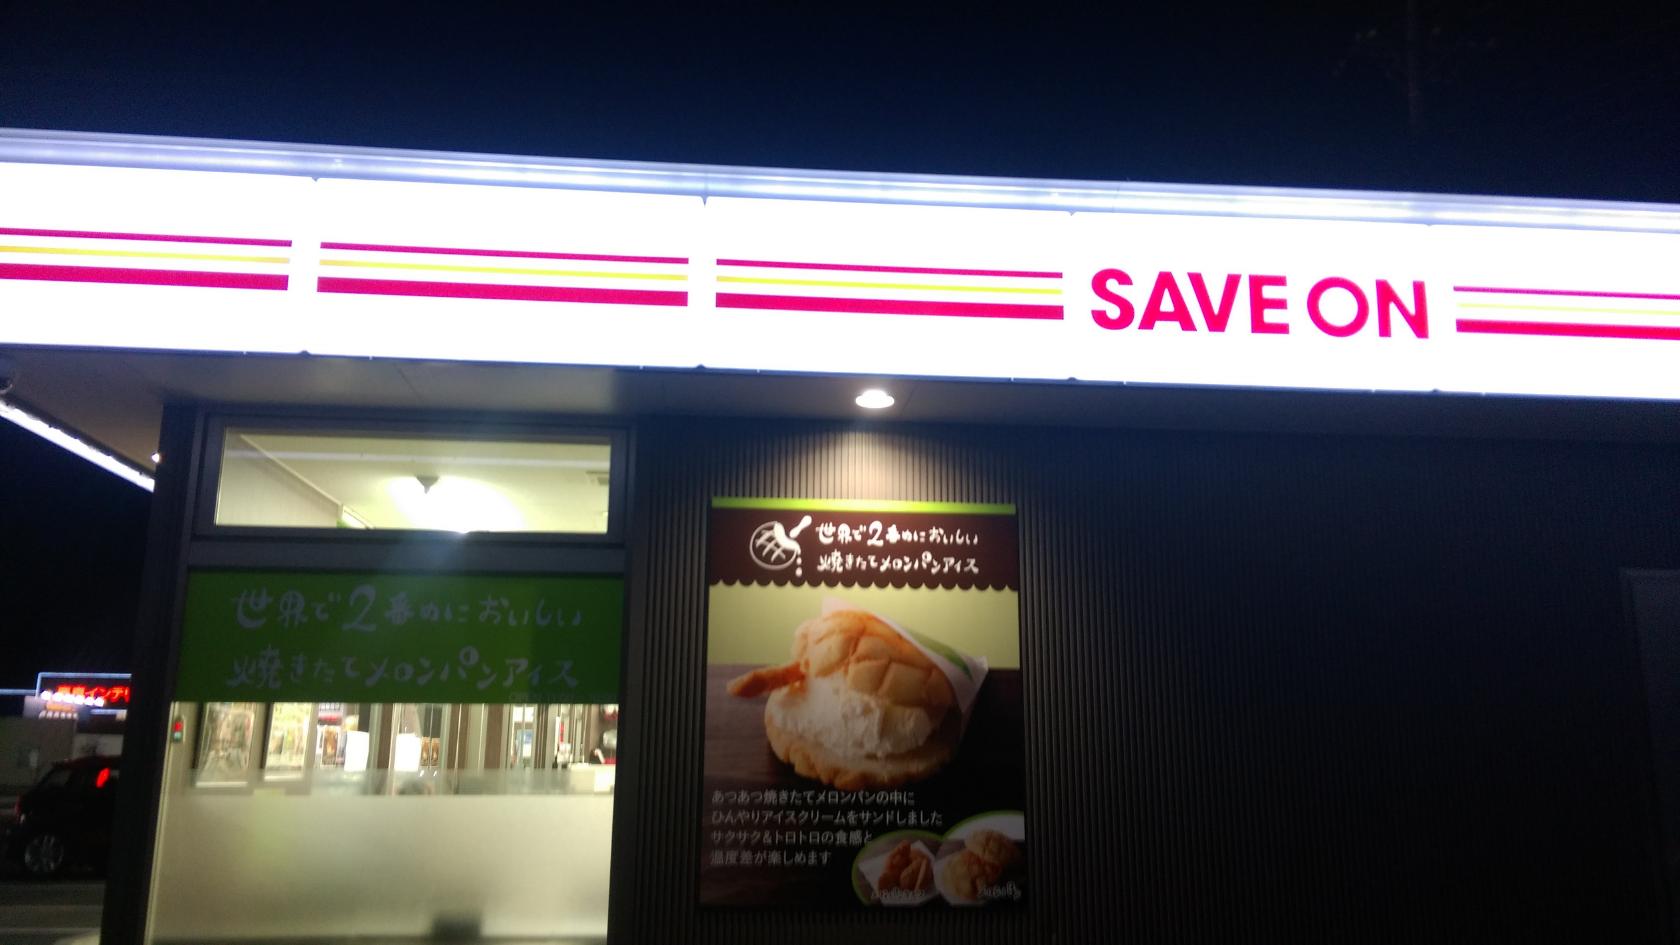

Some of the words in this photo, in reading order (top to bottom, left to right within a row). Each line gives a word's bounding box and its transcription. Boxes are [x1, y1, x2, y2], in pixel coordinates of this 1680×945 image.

[1091, 268, 1290, 334] SAVE
[1307, 276, 1430, 338] ON
[816, 549, 980, 574] 焼きたてメロンパンアイス
[226, 644, 579, 690] 焼きたてメロンパンアイス
[710, 789, 915, 806] あつあつ焼きたてメロンパンの中に
[710, 809, 943, 826] ひんやりアイスクリームをサンドしました
[710, 849, 832, 865] 温度差が楽しめます
